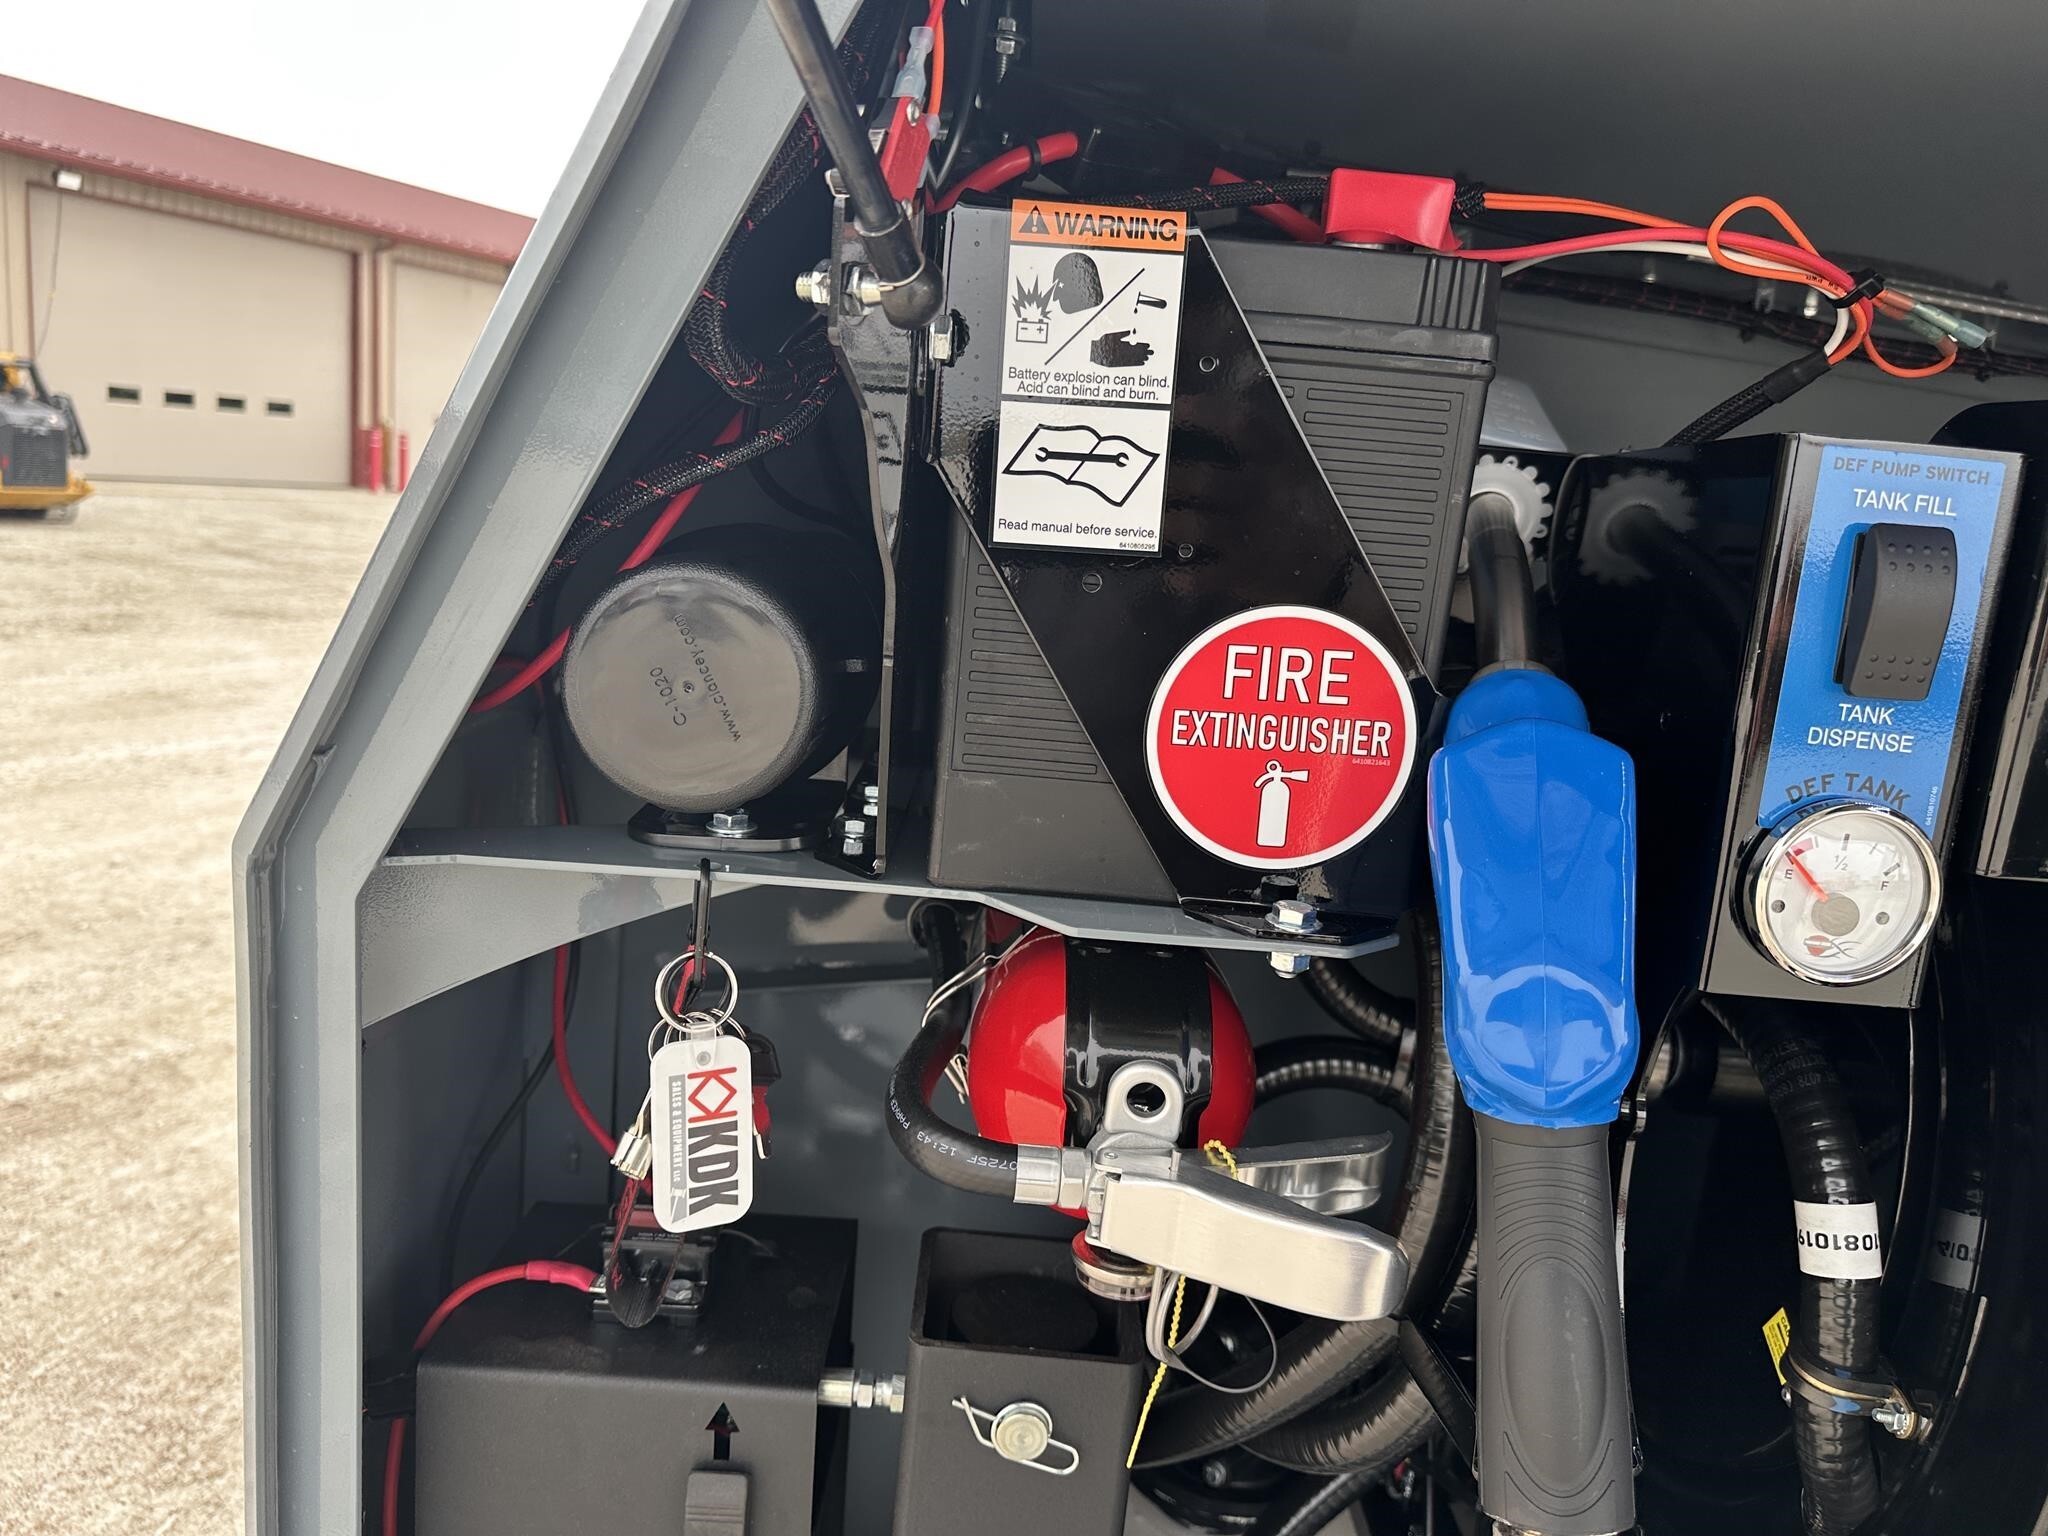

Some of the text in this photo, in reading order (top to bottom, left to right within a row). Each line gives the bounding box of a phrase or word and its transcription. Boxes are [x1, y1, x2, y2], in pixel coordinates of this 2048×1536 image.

[1055, 211, 1177, 242] WARNING
[1008, 367, 1170, 388] Battery explosion can blind.
[1017, 381, 1159, 400] Acid can blind and burn.
[1833, 456, 1991, 485] DEF PUMP SWITCH
[1853, 488, 1958, 516] TANK FILL
[998, 518, 1158, 539] Read manual before service.
[672, 613, 741, 743] www.clancey.com
[1222, 644, 1355, 706] FIRE
[649, 666, 687, 727] C-1020
[1838, 704, 1895, 726] TANK
[1171, 708, 1393, 757] EXTINGUISHER
[1807, 727, 1914, 754] DISPENSE
[1785, 773, 1912, 809] DEF TANK
[1784, 868, 1794, 880] E
[1880, 880, 1889, 890] F
[671, 1081, 683, 1107] SALES
[672, 1119, 683, 1169] EQUIPMENT
[916, 1131, 958, 1157] 12:43
[688, 1119, 739, 1216] KDK
[1797, 1231, 1880, 1252] 1081019
